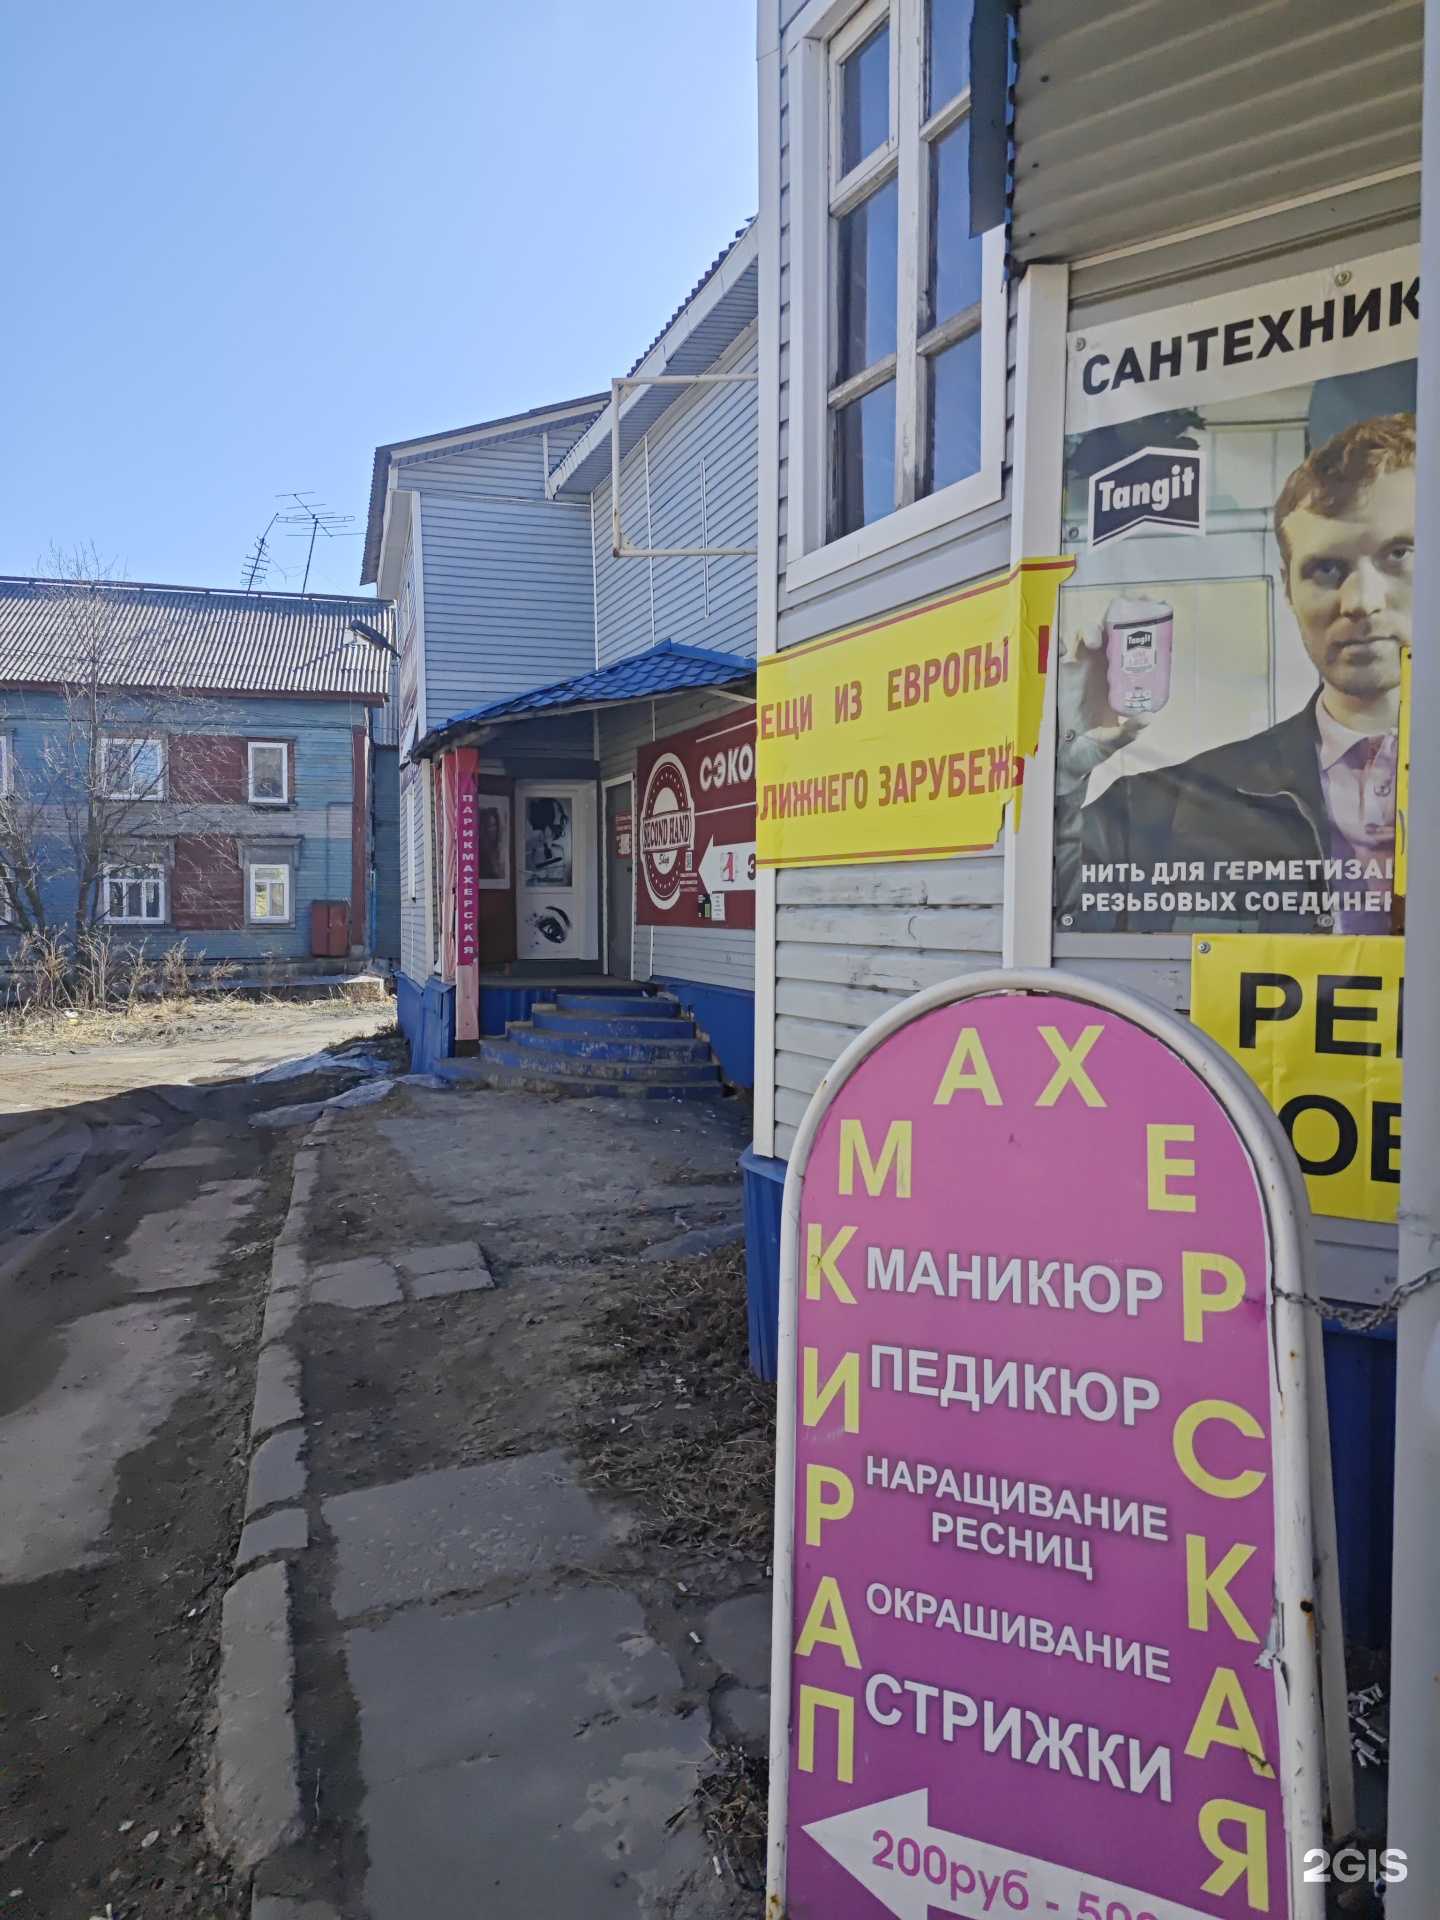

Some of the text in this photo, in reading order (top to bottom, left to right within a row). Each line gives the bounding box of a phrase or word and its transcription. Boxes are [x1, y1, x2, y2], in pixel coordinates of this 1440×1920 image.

[1082, 276, 1420, 396] САНТЕХНИК
[1098, 464, 1196, 512] Tangit
[757, 694, 813, 740] ЕЩИ
[834, 680, 862, 724] ИЗ
[887, 636, 1009, 712] ЕВРОПЫ
[643, 819, 669, 849] SECOND
[669, 813, 690, 846] HAND
[757, 770, 869, 821] ЛИЖНЕГО
[462, 794, 475, 954] ПАРИКМАХЕРСКАЯ
[1081, 864, 1145, 883] НИТЬ
[1151, 862, 1205, 885] ДЛЯ
[1081, 892, 1237, 912] РЕЗЬБОВЫХ
[1239, 971, 1404, 1059] РЕ
[866, 1246, 1163, 1317] МАНИКЮР
[871, 1344, 1161, 1427] ПЕДИКЮР
[866, 1455, 1169, 1542] НАРАЩИВАНИЕ
[931, 1511, 1095, 1581] РЕСНИЦ
[866, 1582, 1171, 1684] ОКРАШИВАНИЕ
[865, 1673, 1173, 1803] СТРИЖКИ
[872, 1829, 1030, 1912] 200руб
